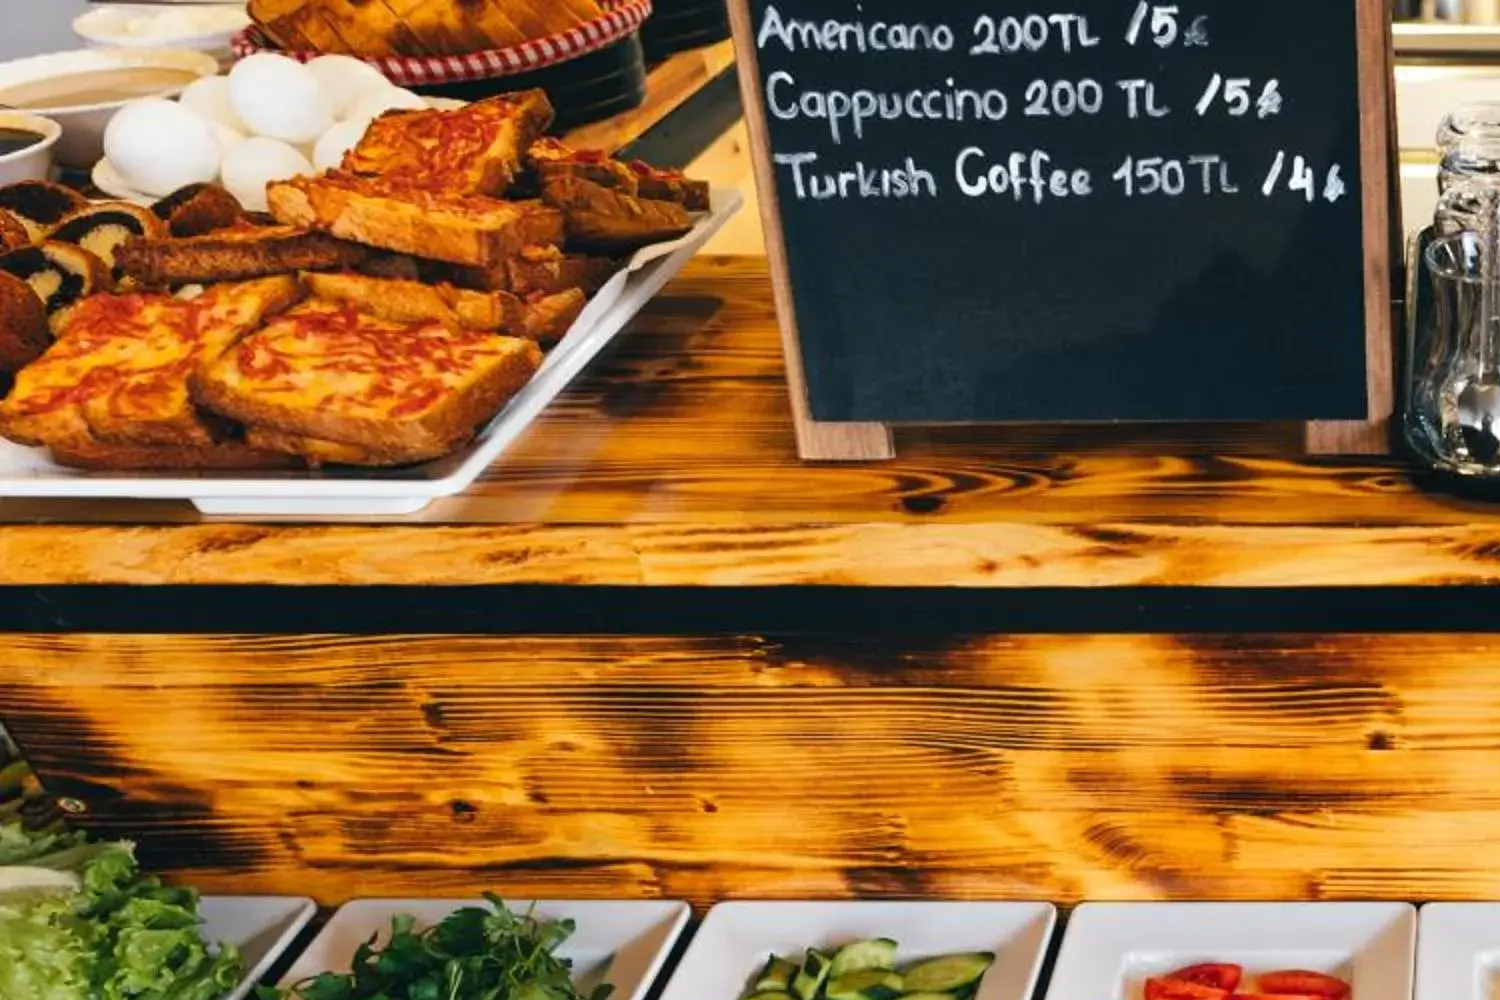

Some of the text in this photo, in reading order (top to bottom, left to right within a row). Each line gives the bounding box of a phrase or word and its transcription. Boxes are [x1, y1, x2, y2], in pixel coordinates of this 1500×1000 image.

[757, 4, 954, 52] Americano
[766, 71, 1008, 144] Cappuccino
[1024, 78, 1103, 117] 200
[1116, 79, 1170, 118] TL
[774, 152, 937, 198] Turkish
[955, 146, 1092, 204] Coffee
